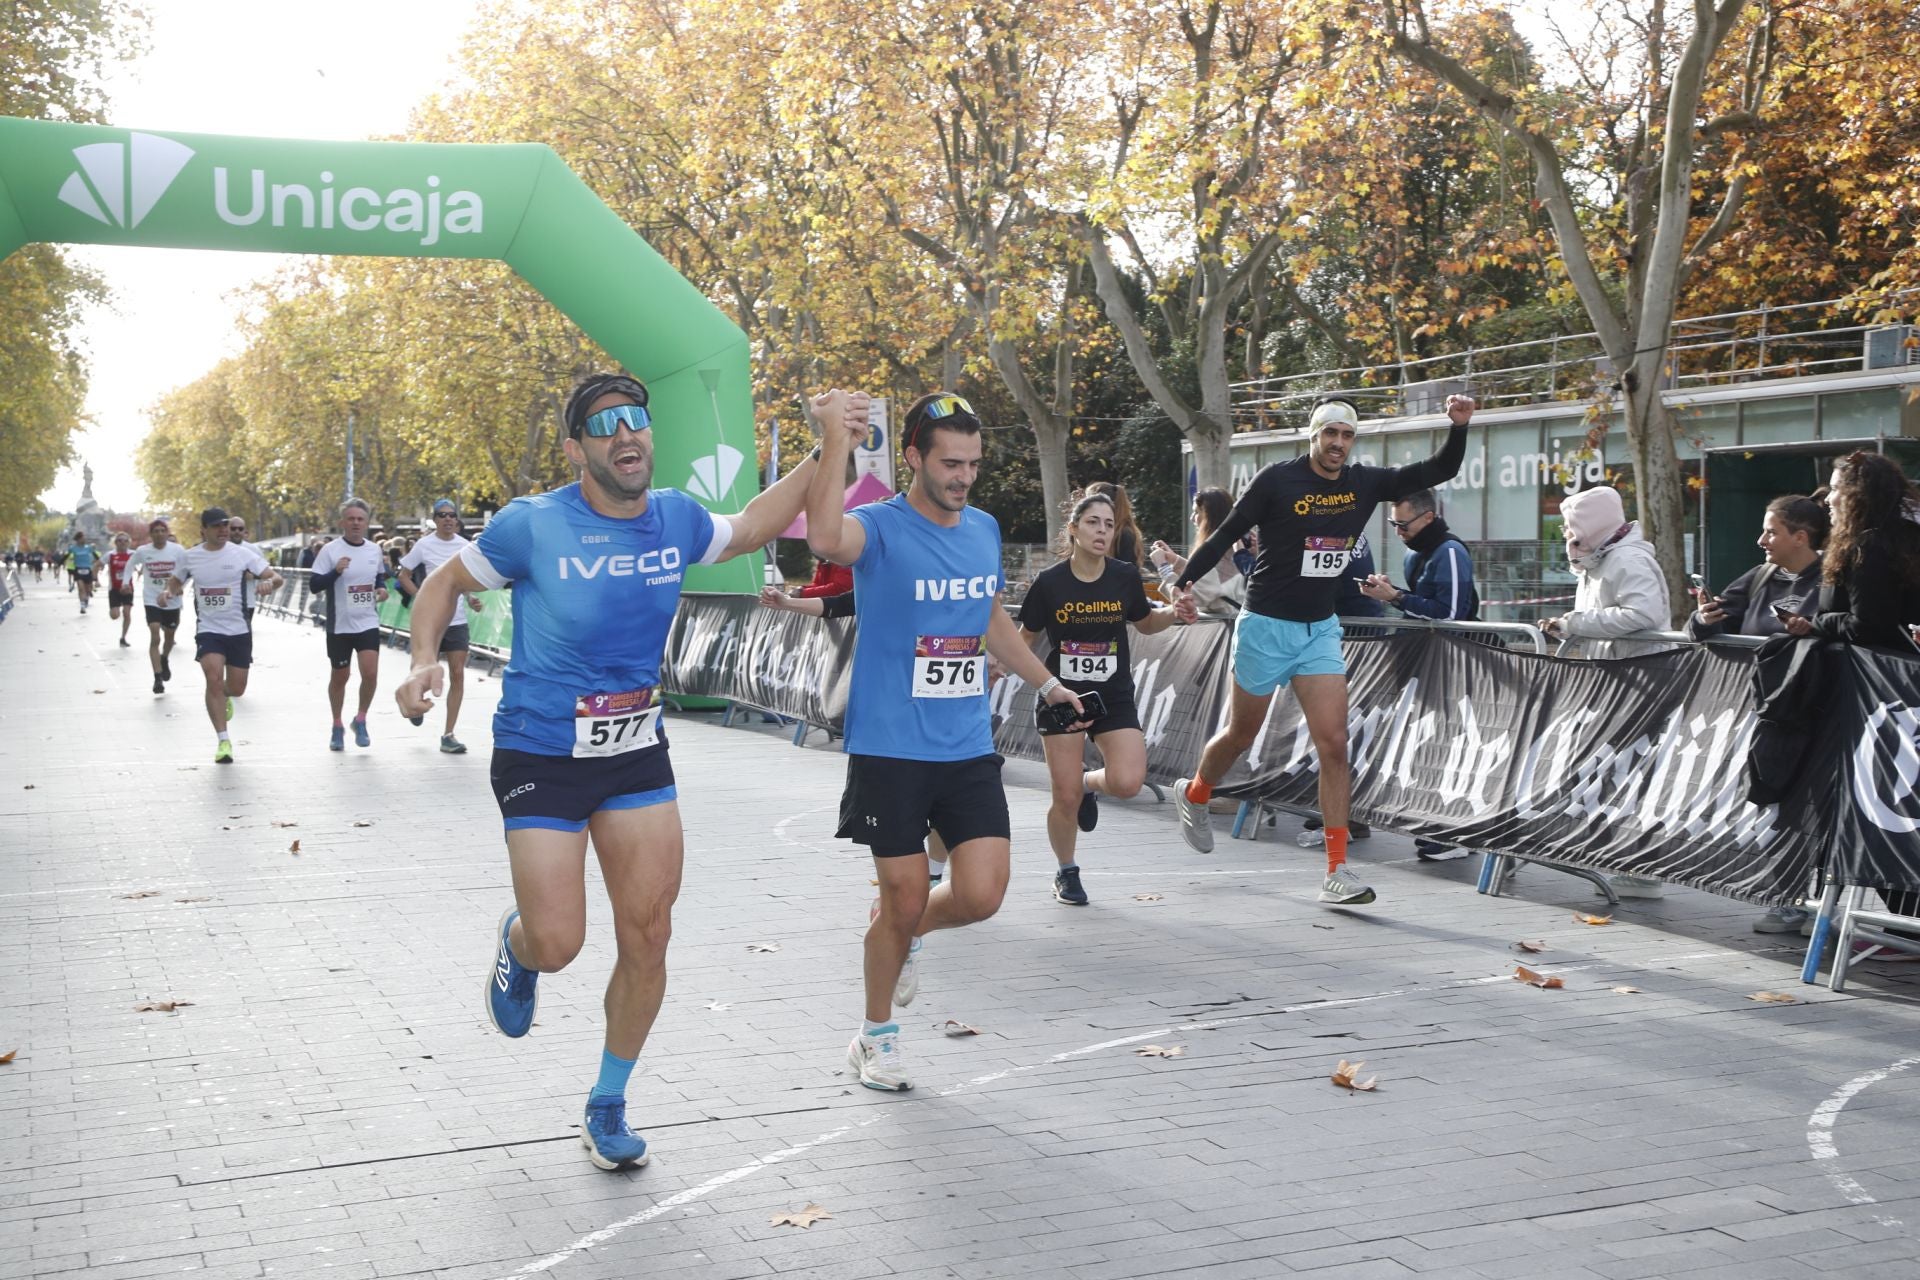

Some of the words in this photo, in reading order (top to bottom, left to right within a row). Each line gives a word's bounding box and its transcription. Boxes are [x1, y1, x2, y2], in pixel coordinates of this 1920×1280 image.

[214, 166, 483, 246] Unicaja
[1500, 439, 1605, 496] amiga
[1315, 492, 1356, 505] CellMat
[558, 546, 680, 579] IVECO
[1311, 552, 1344, 569] 195
[646, 572, 681, 586] running
[915, 575, 998, 601] IVECO
[204, 596, 226, 606] 959
[353, 592, 372, 604] 958
[1076, 600, 1121, 613] CellMat
[1070, 614, 1122, 624] Technologies
[925, 660, 975, 685] 576
[1068, 657, 1108, 674] 194
[590, 712, 649, 747] 577
